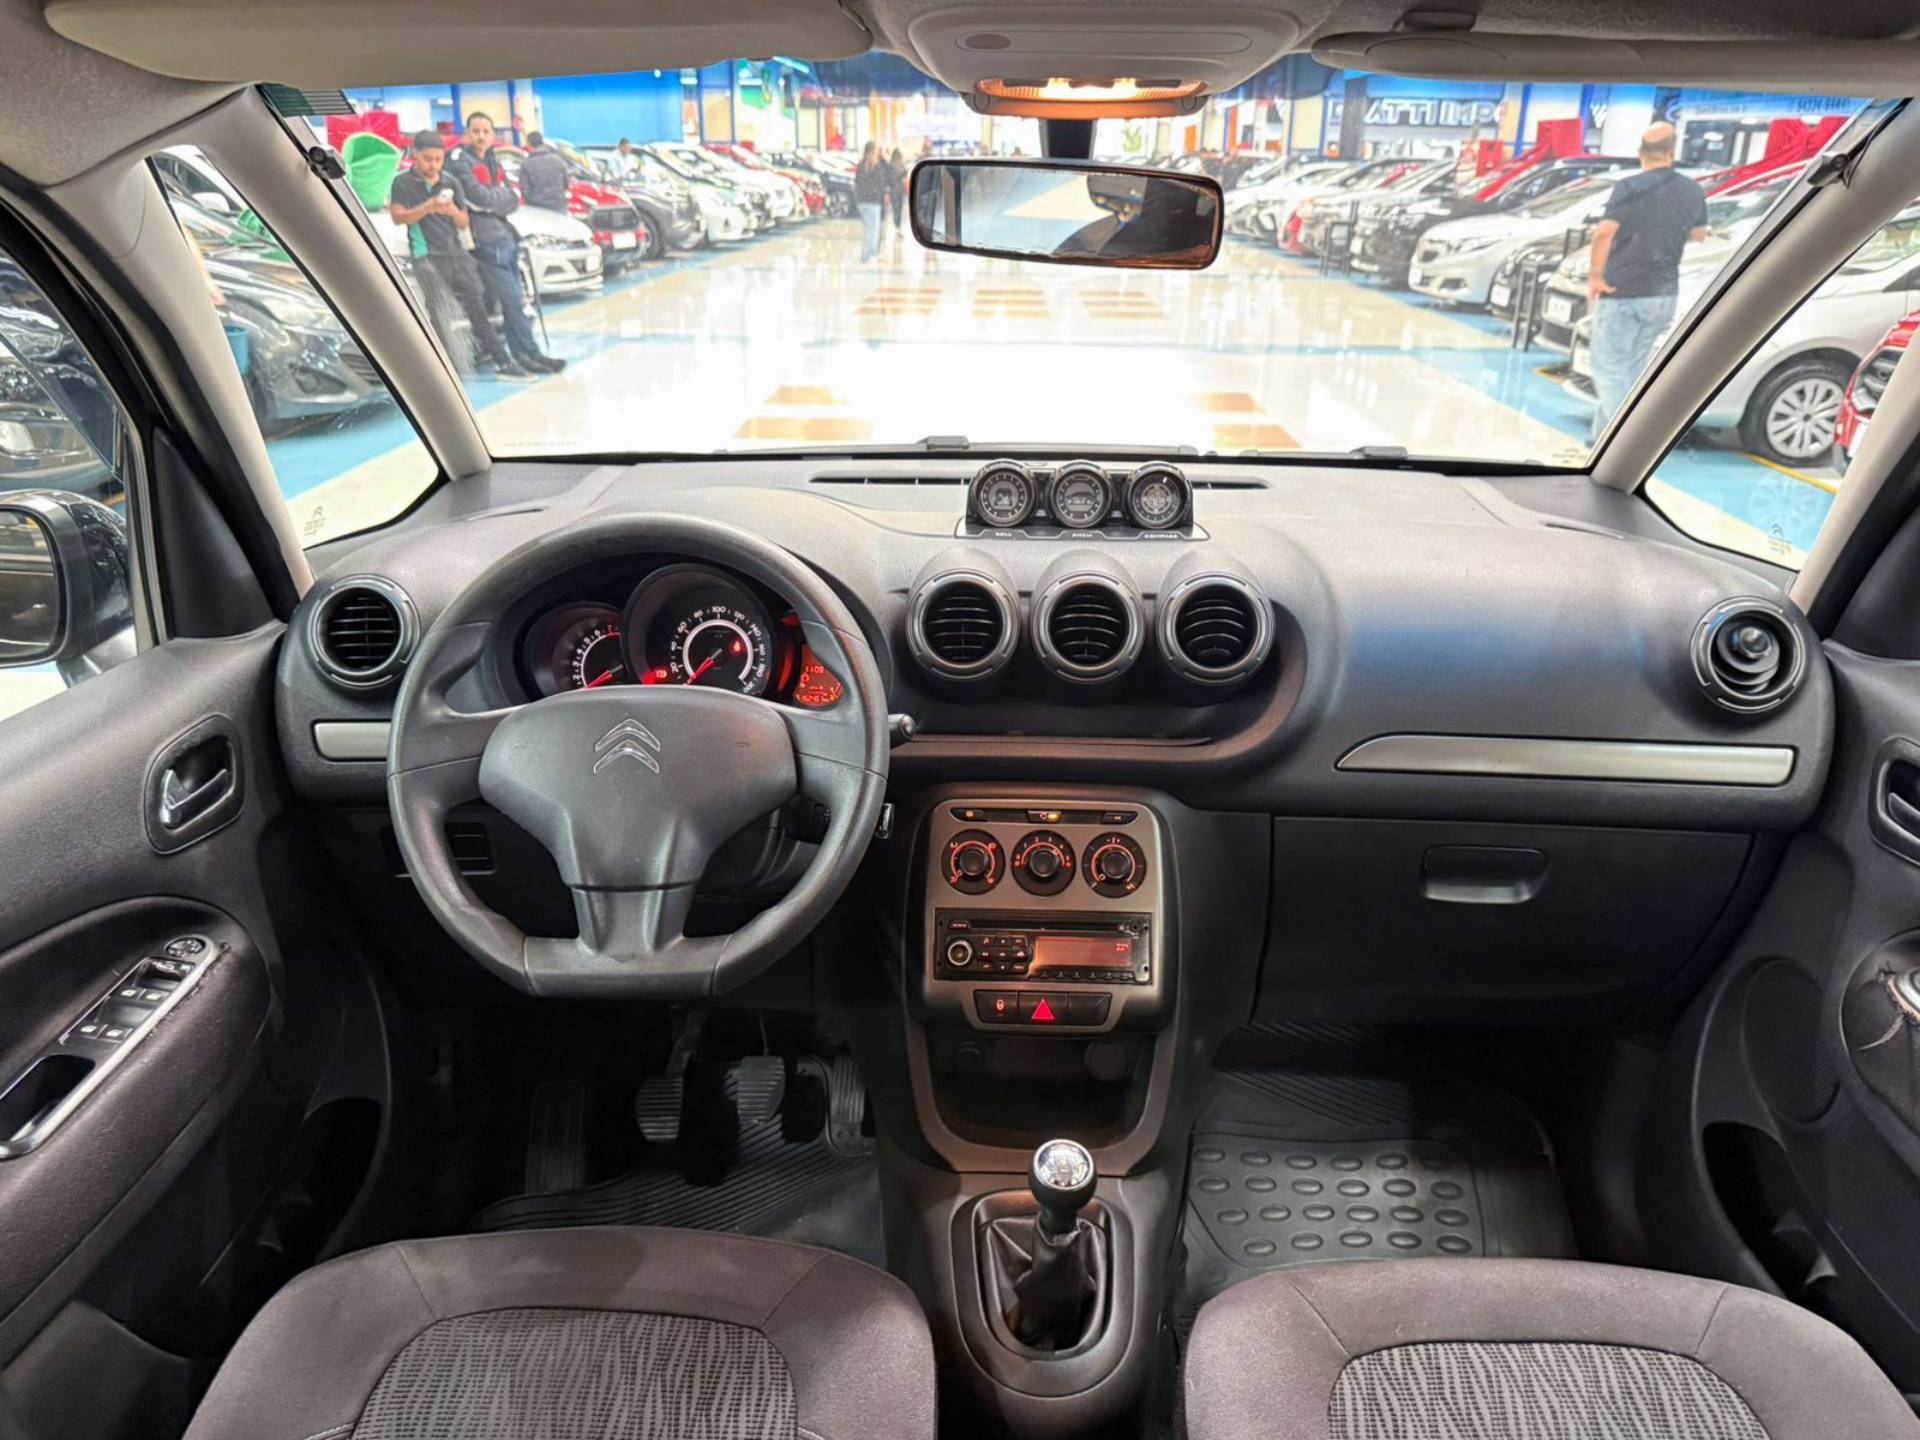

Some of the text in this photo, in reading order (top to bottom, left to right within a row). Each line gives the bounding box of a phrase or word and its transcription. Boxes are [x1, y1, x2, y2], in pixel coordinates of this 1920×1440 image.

[677, 621, 687, 633] 60
[750, 623, 762, 637] 140
[670, 662, 679, 673] 20
[756, 663, 766, 677] 180
[743, 681, 755, 693] 200
